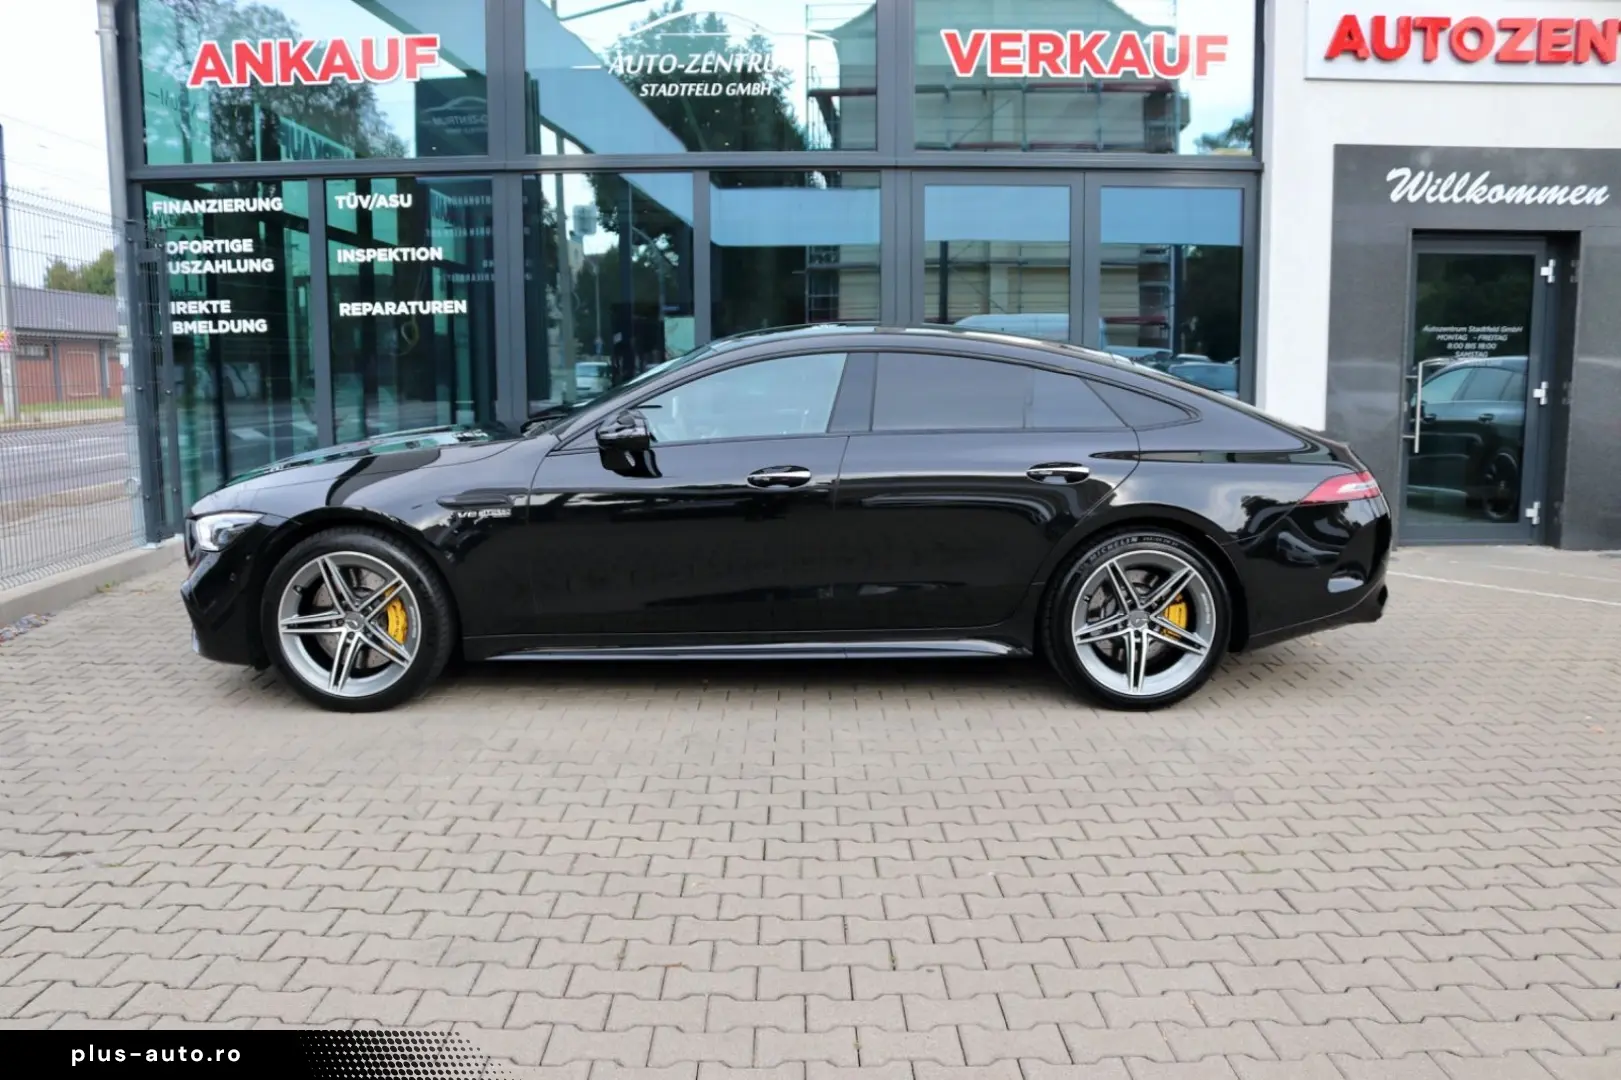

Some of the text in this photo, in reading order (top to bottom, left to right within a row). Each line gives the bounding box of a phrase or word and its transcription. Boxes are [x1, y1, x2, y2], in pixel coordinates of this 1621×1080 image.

[1324, 14, 1621, 64] AUTOZEN
[187, 34, 440, 88] ANKAUF
[940, 29, 1229, 79] VERKAUF
[608, 52, 777, 75] AUTO-ZENTRU
[640, 83, 772, 97] STADTFELD GMBH
[1386, 167, 1610, 206] Willkommen
[152, 197, 283, 214] FINANZIERUNG
[335, 192, 413, 211] TÜV/ASU
[166, 239, 254, 255] OFORTIGE
[337, 247, 443, 263] INSPEKTION
[168, 258, 275, 275] USZAHLUNG
[170, 299, 232, 315] IREKTE
[339, 300, 467, 316] REPARATUREN
[172, 319, 268, 335] BMELDUNG
